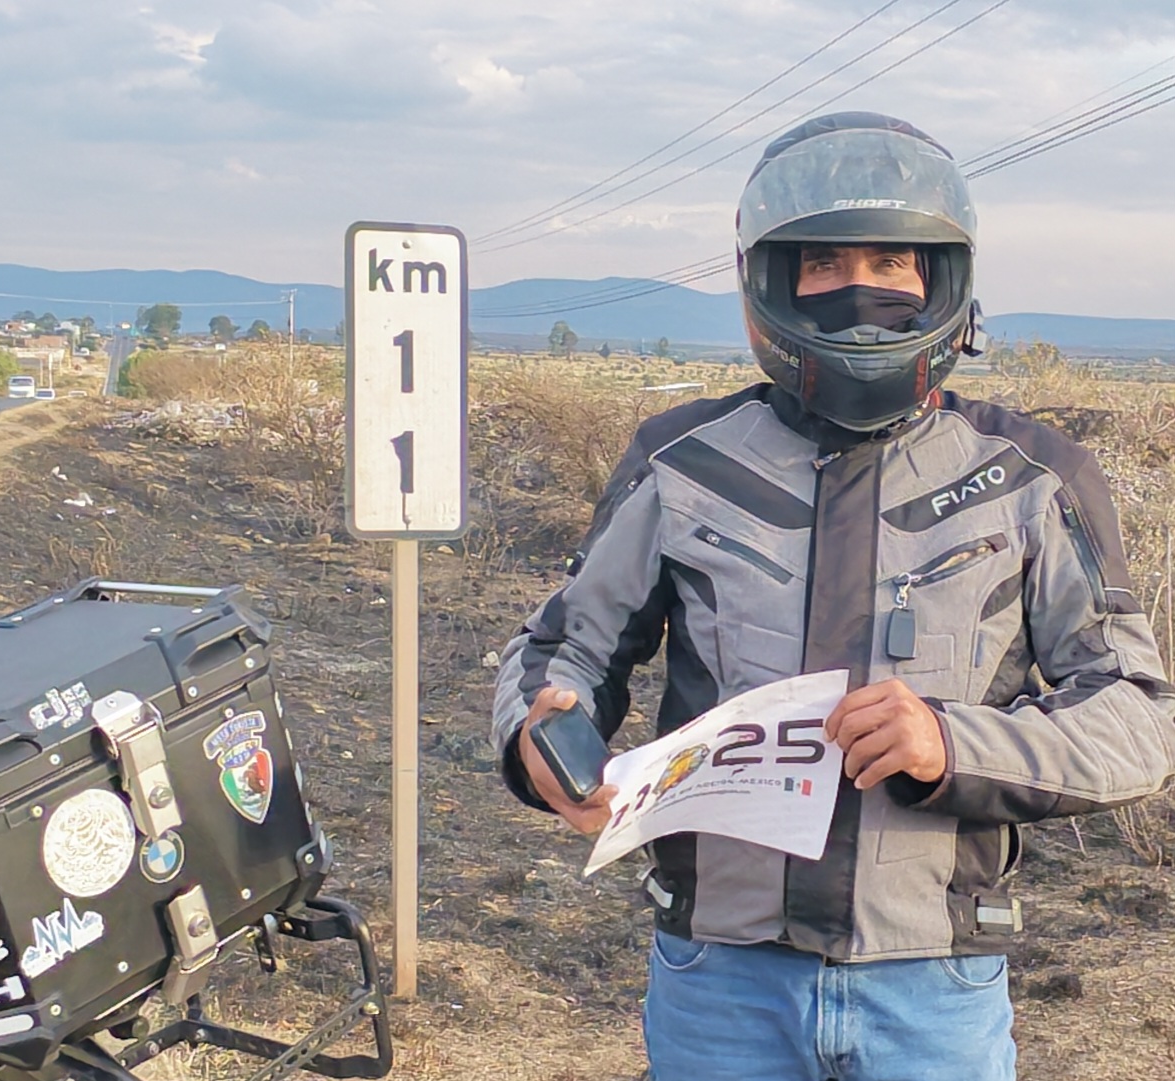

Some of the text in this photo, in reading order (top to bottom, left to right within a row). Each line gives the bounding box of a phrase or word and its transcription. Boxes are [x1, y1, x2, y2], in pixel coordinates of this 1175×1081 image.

[368, 247, 447, 294] km
[392, 329, 414, 394] 1
[389, 430, 414, 494] 1
[930, 465, 1006, 517] FIATO
[711, 718, 826, 767] 25
